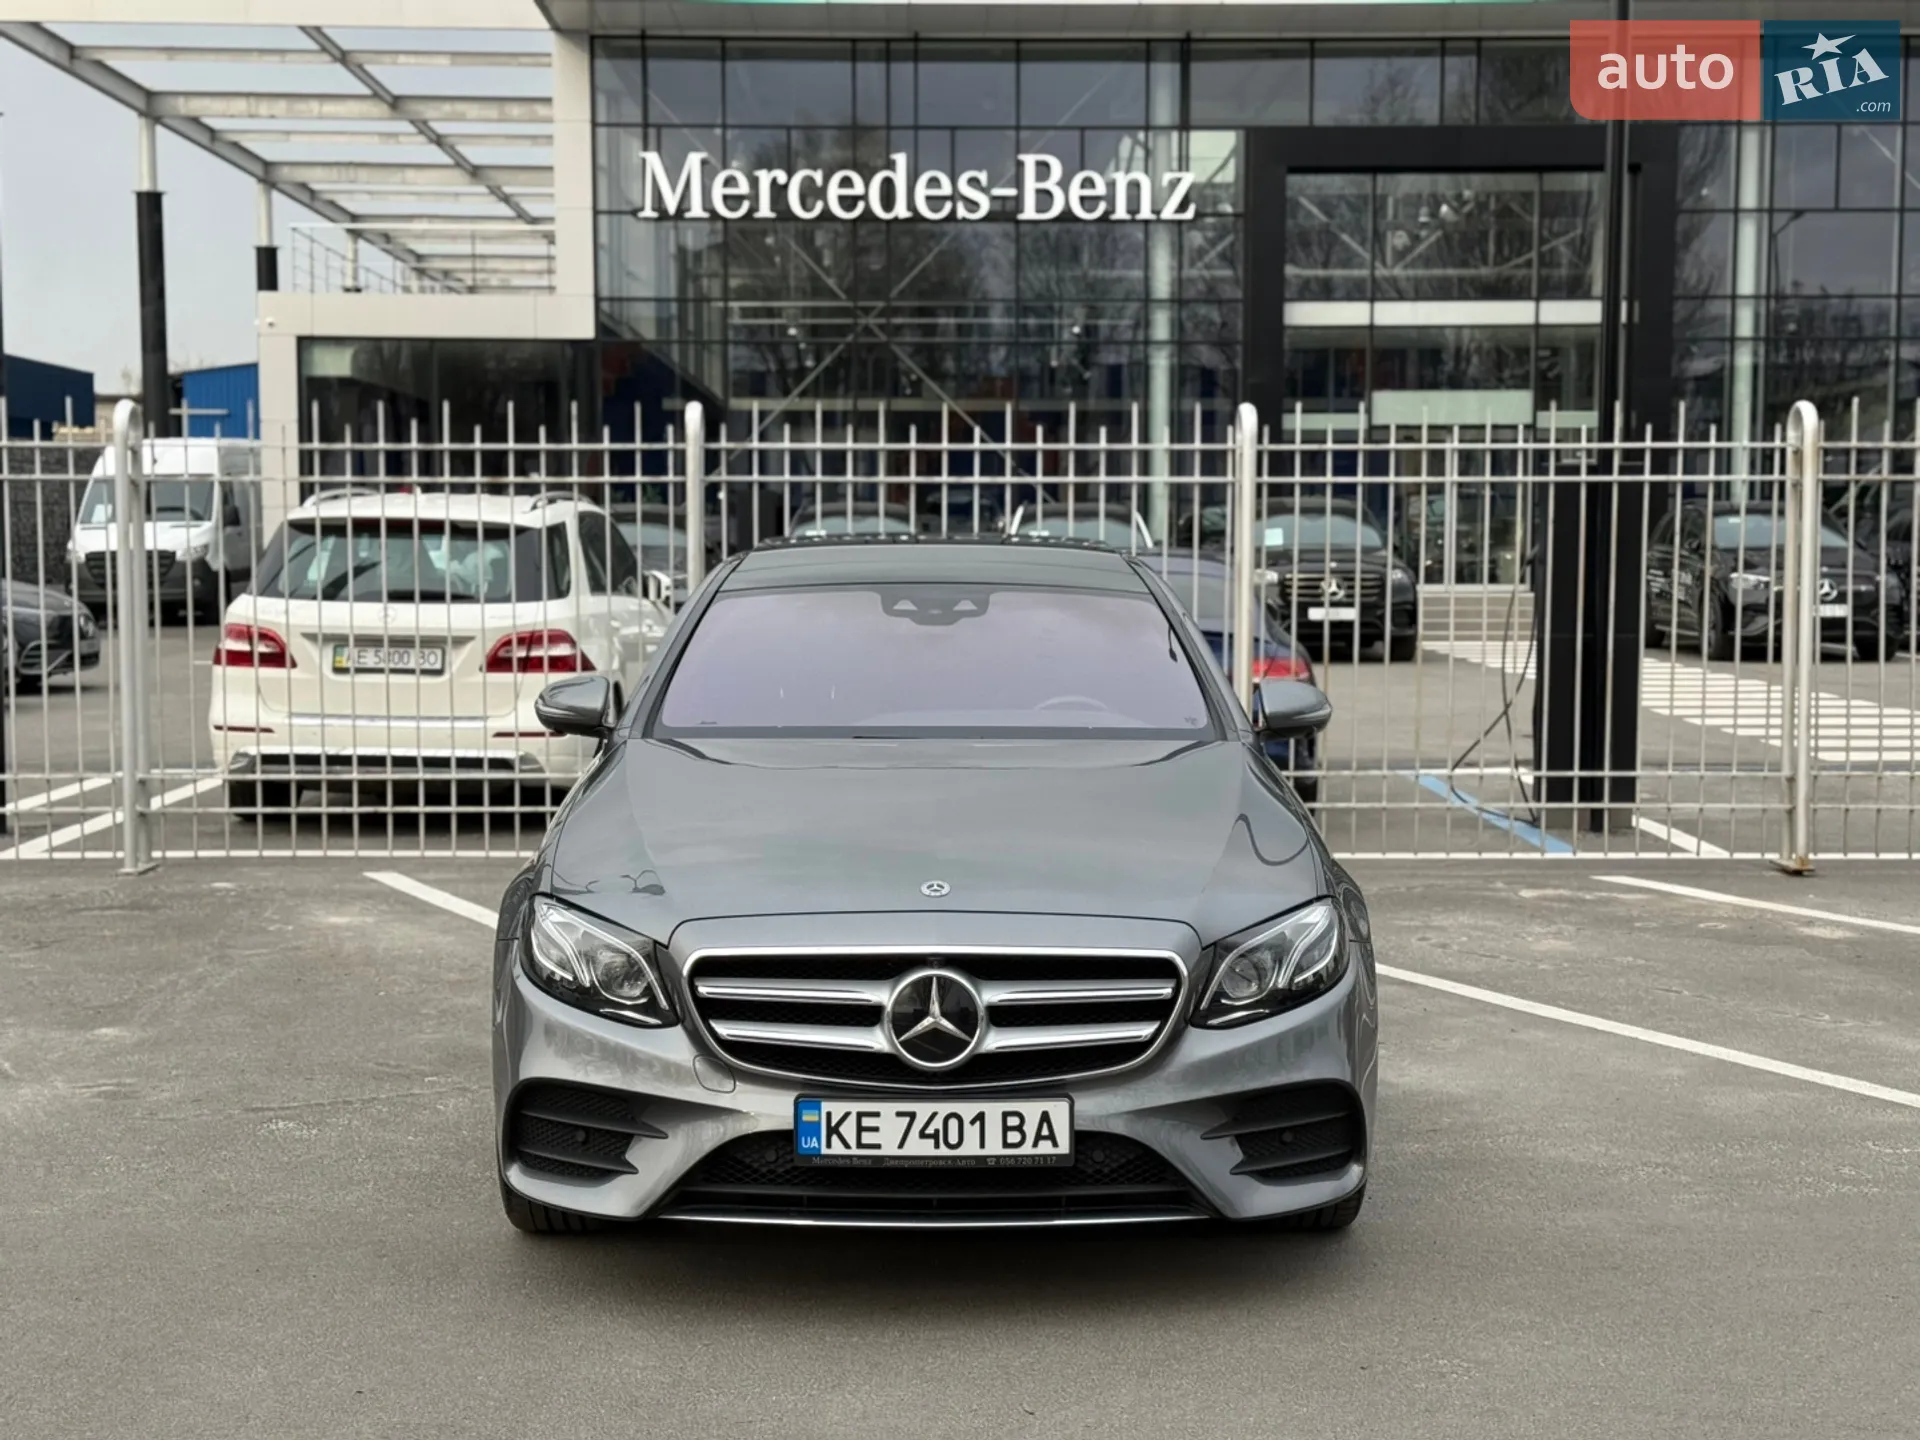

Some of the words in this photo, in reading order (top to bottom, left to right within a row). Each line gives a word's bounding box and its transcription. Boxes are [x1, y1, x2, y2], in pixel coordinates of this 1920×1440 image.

[637, 151, 1197, 222] Mercedes-Benz
[801, 1136, 820, 1149] UA
[825, 1110, 882, 1150] KE
[895, 1110, 986, 1151] 7401
[1001, 1110, 1060, 1150] BA
